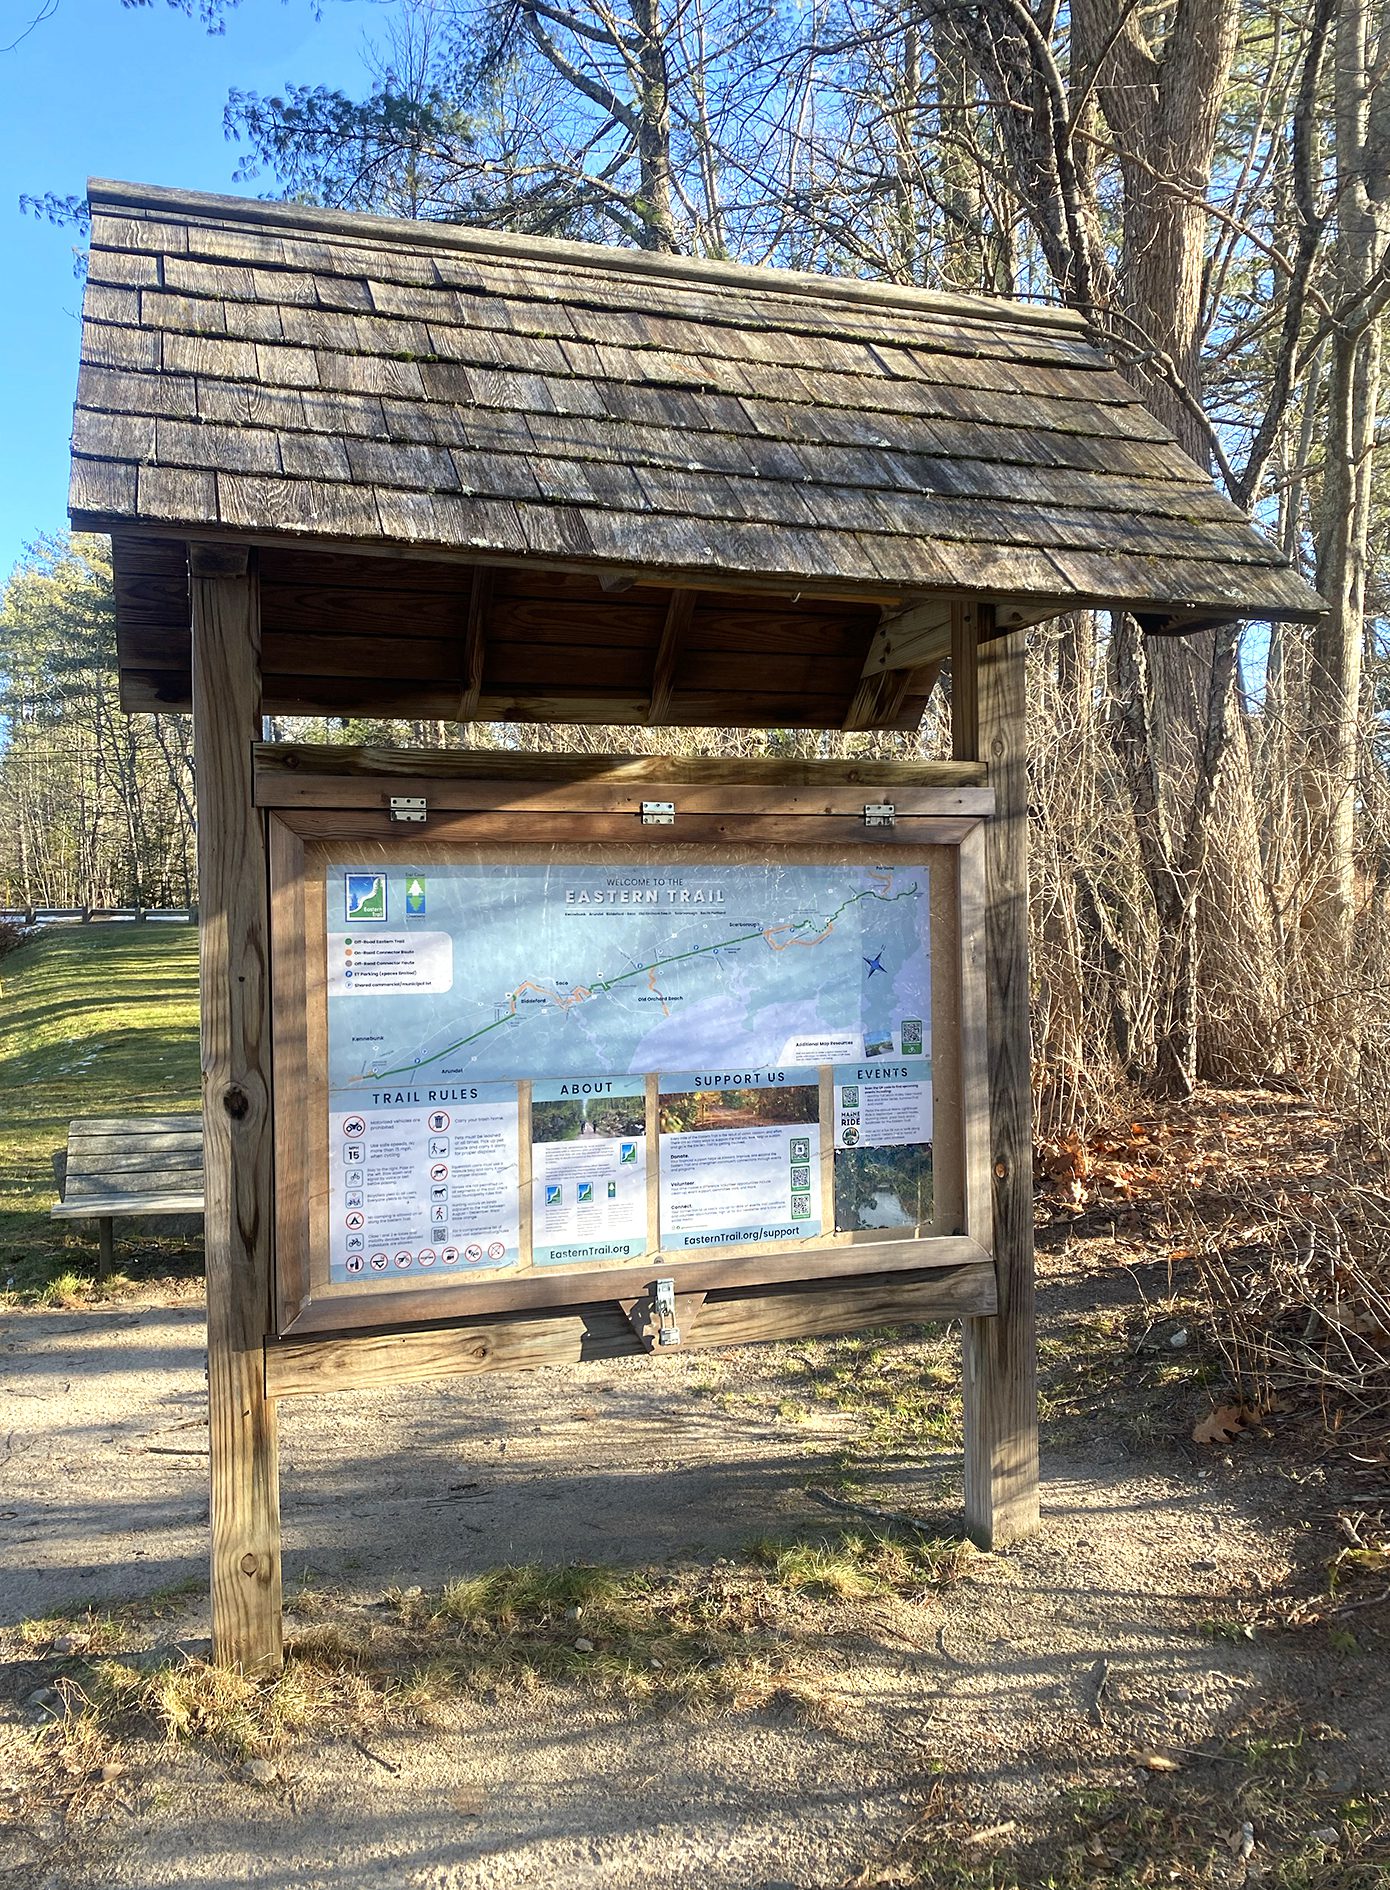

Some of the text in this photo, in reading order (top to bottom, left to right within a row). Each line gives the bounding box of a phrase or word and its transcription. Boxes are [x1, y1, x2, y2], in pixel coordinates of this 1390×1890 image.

[565, 889, 725, 904] EASTERN TRAIL
[694, 1072, 785, 1087] SUPPORT US
[857, 1067, 908, 1080] EVENTS
[372, 1088, 478, 1104] TRAIL RULES
[560, 1082, 613, 1095] ABOUT
[348, 1151, 360, 1160] 15
[684, 1226, 800, 1246] EasternTrail.org/support
[550, 1244, 630, 1259] EasternTrail.org
